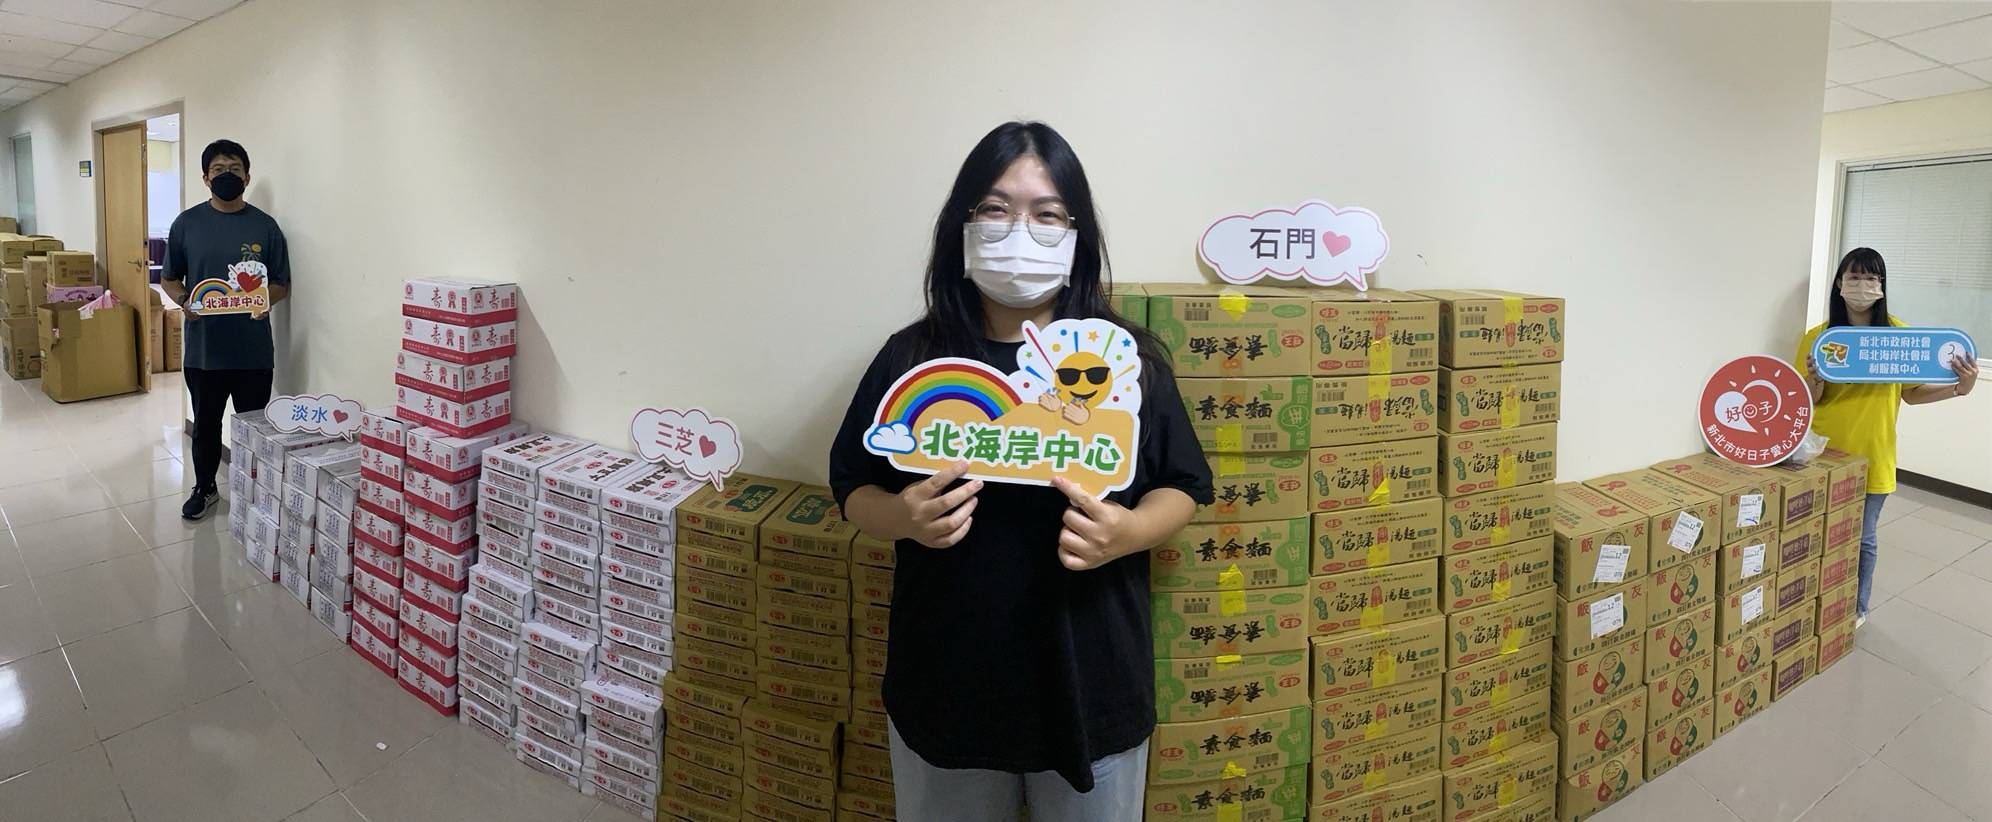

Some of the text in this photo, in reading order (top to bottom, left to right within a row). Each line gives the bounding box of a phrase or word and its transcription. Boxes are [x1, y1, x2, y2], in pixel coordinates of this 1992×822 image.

[1249, 228, 1315, 259] 石門
[205, 295, 265, 309] 北海岸中心
[1189, 334, 1268, 361] 素食麵
[1859, 336, 1931, 348] 新北市政府社會
[291, 404, 328, 423] 淡水
[1195, 395, 1273, 421] 素食麵
[655, 421, 694, 456] 三芝
[1706, 406, 1809, 461] 新北市好日子愛心大平台
[922, 422, 1121, 472] 北海岸中心
[1661, 517, 1672, 532] 飯
[1195, 537, 1273, 562] 素食麵
[1581, 537, 1593, 553] 飯
[1577, 602, 1590, 617] 飯
[1189, 620, 1265, 645] 素食麵
[1190, 681, 1265, 707] 素食麵
[1199, 728, 1273, 755] 素食麵
[1191, 785, 1266, 810] 素食麵
